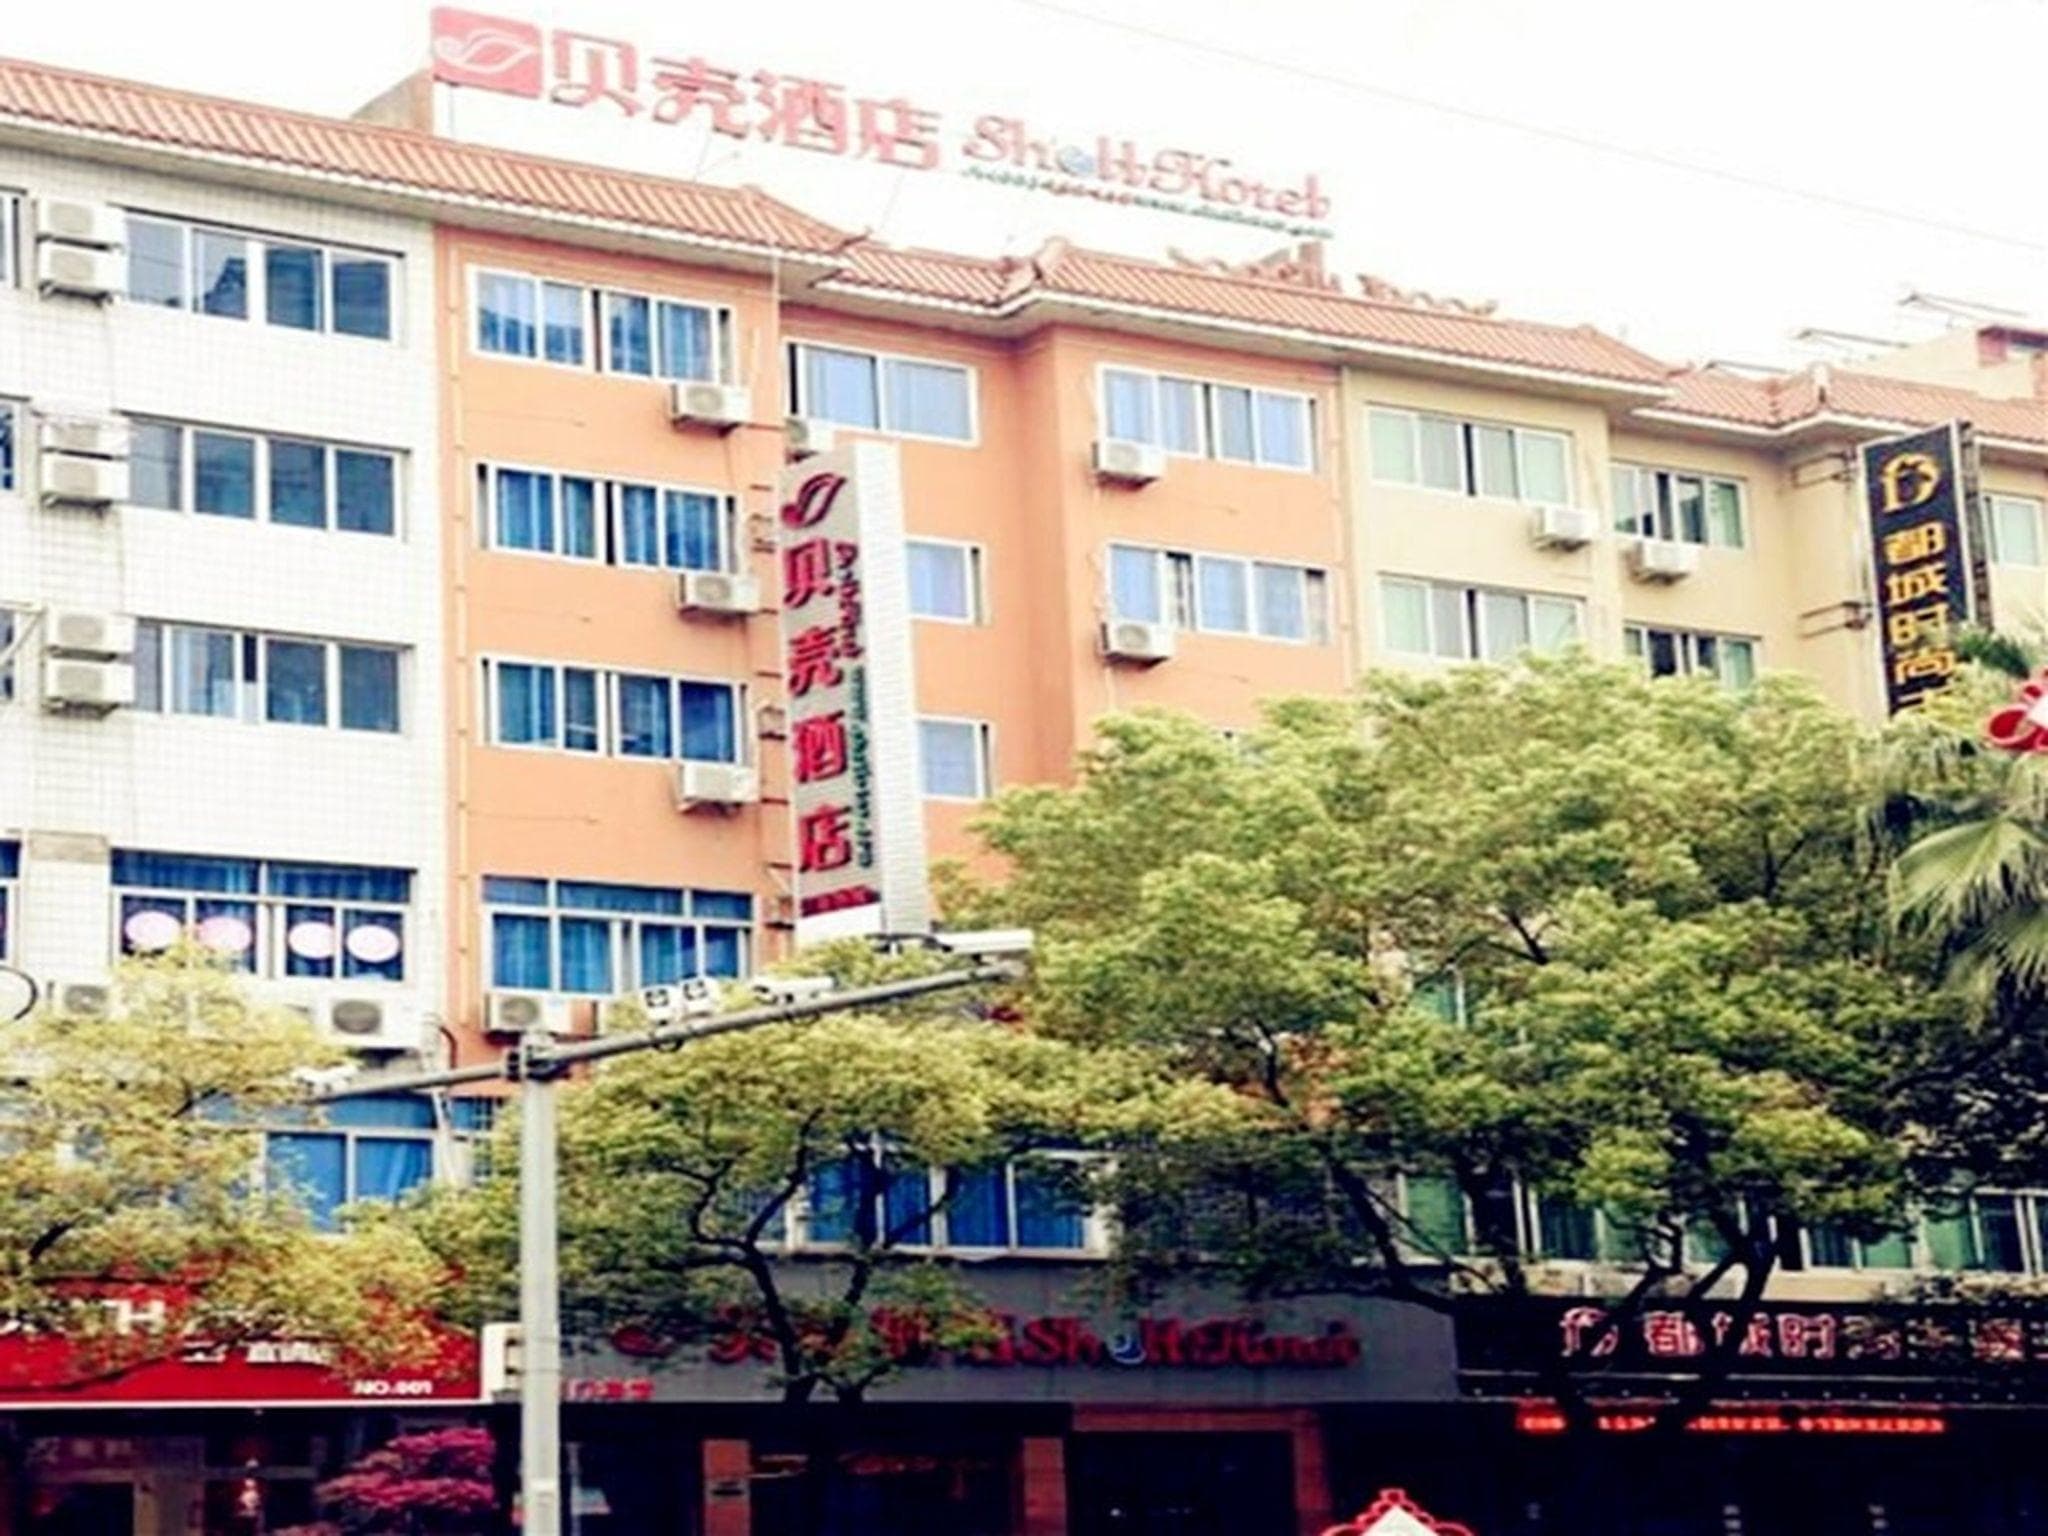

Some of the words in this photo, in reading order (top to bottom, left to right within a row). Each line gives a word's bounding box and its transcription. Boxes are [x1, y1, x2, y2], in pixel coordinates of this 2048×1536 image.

[550, 29, 941, 170] 贝壳酒店
[784, 539, 852, 873] 贝壳酒店
